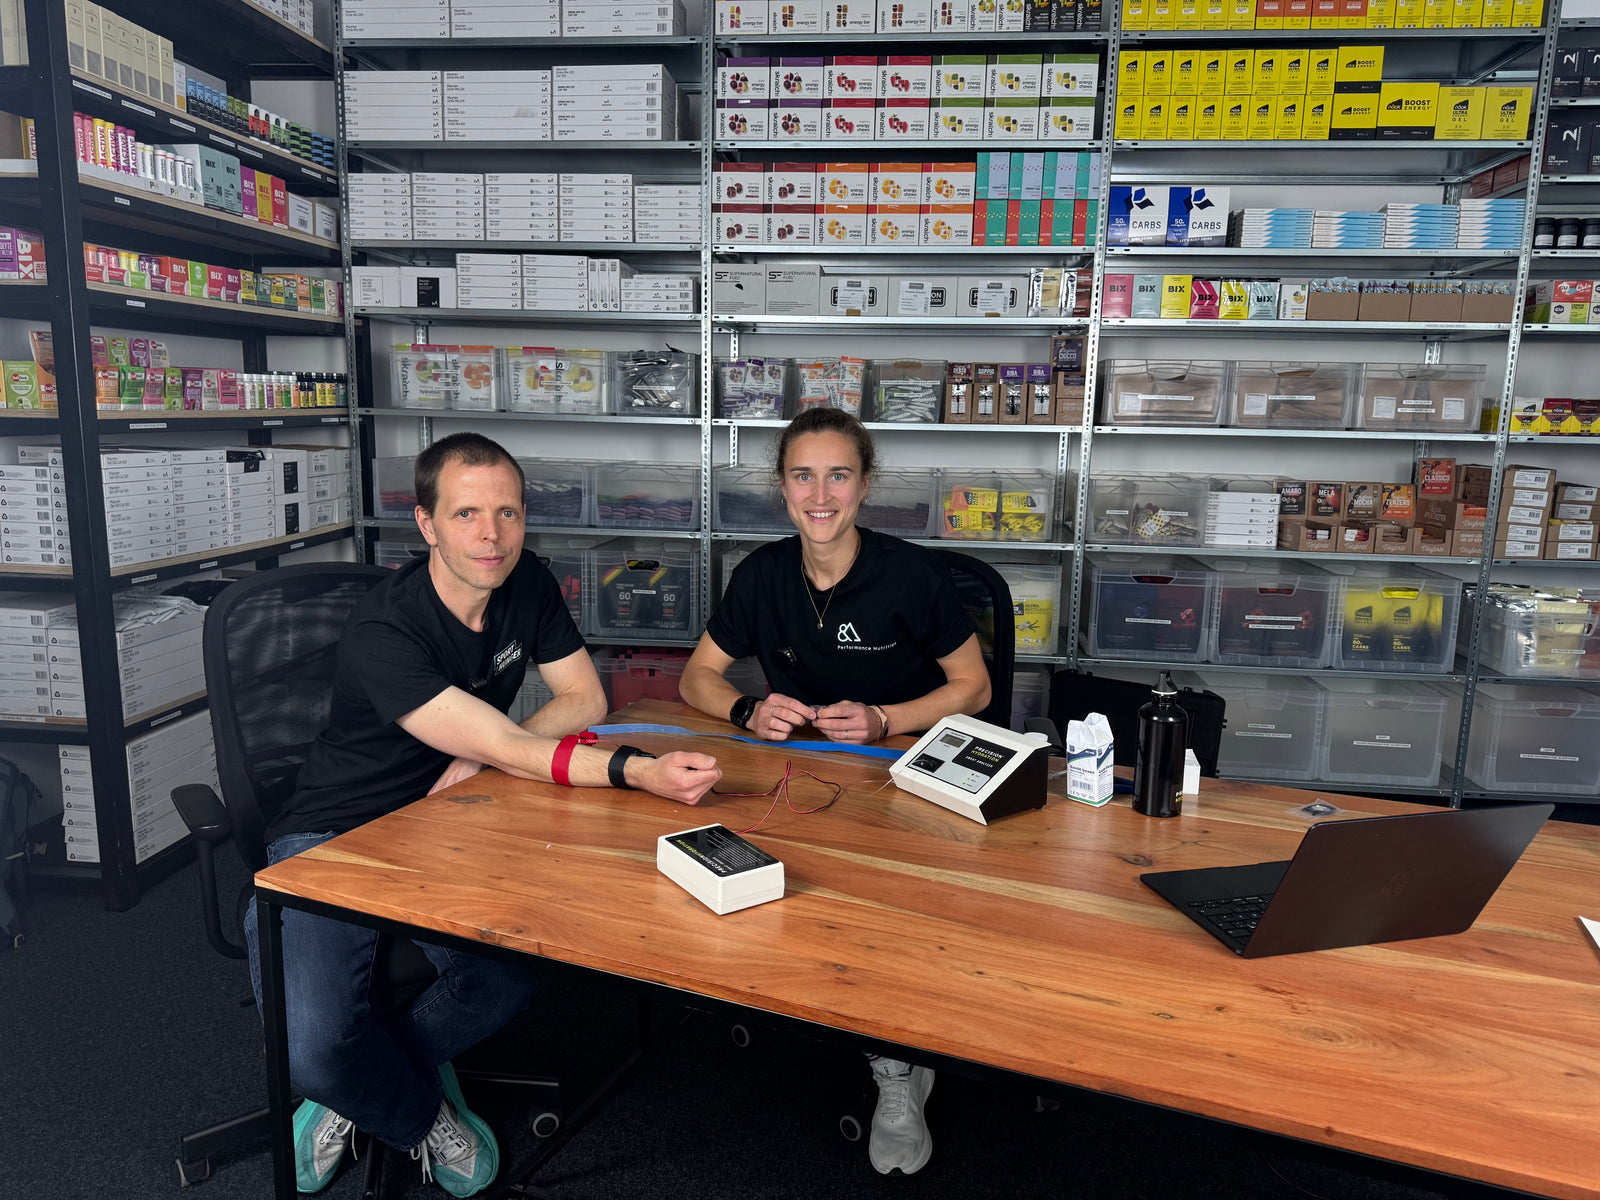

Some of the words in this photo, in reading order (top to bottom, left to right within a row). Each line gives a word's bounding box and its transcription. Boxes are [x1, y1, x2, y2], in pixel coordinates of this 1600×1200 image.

[205, 159, 216, 168] BIX
[226, 166, 236, 175] BIX
[243, 180, 254, 190] BIX
[170, 188, 179, 196] PH
[274, 189, 285, 199] BIX
[1132, 221, 1162, 229] CARBS
[1191, 221, 1221, 230] CARBS
[173, 264, 186, 274] BIX
[210, 271, 223, 280] BIX
[228, 274, 239, 283] BIX
[714, 271, 729, 280] SF
[768, 271, 782, 279] SF
[1138, 285, 1156, 293] BIX
[1168, 285, 1185, 293] BIX
[619, 592, 631, 600] 60
[663, 594, 676, 602] 60
[497, 644, 515, 665] SPORT
[971, 750, 1000, 763] HYDRATION
[974, 746, 1003, 759] PRECISION
